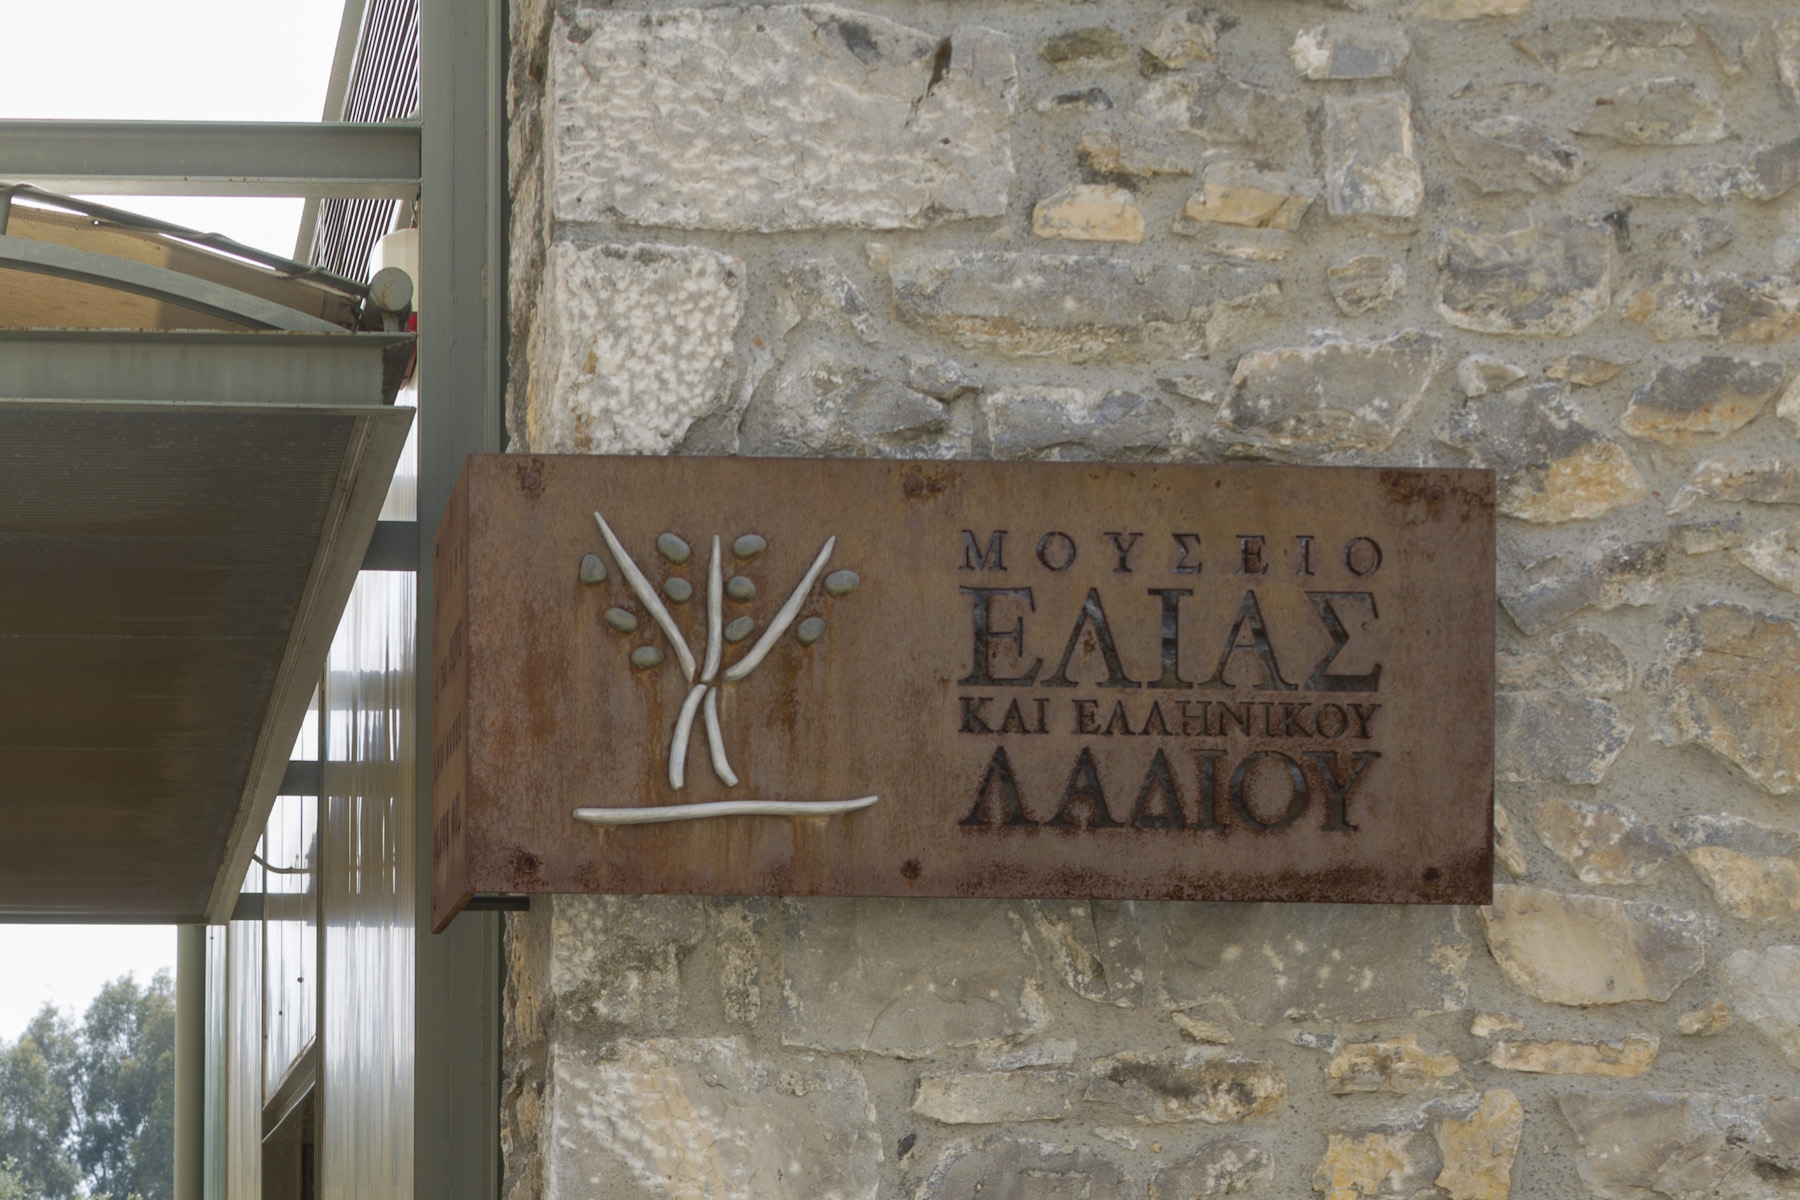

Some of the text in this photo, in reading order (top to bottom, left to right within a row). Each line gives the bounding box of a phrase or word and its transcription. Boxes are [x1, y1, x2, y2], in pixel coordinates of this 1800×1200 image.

[958, 529, 1383, 576] ΜΟΥΣΕΙΟ
[957, 585, 1383, 693] ΕΛΙΑΣ
[958, 696, 1383, 739] ΚΑΙ ΕΛΛΗΝΙΚΟΥ
[957, 745, 1383, 832] ΛΑΔΙΟΥ
